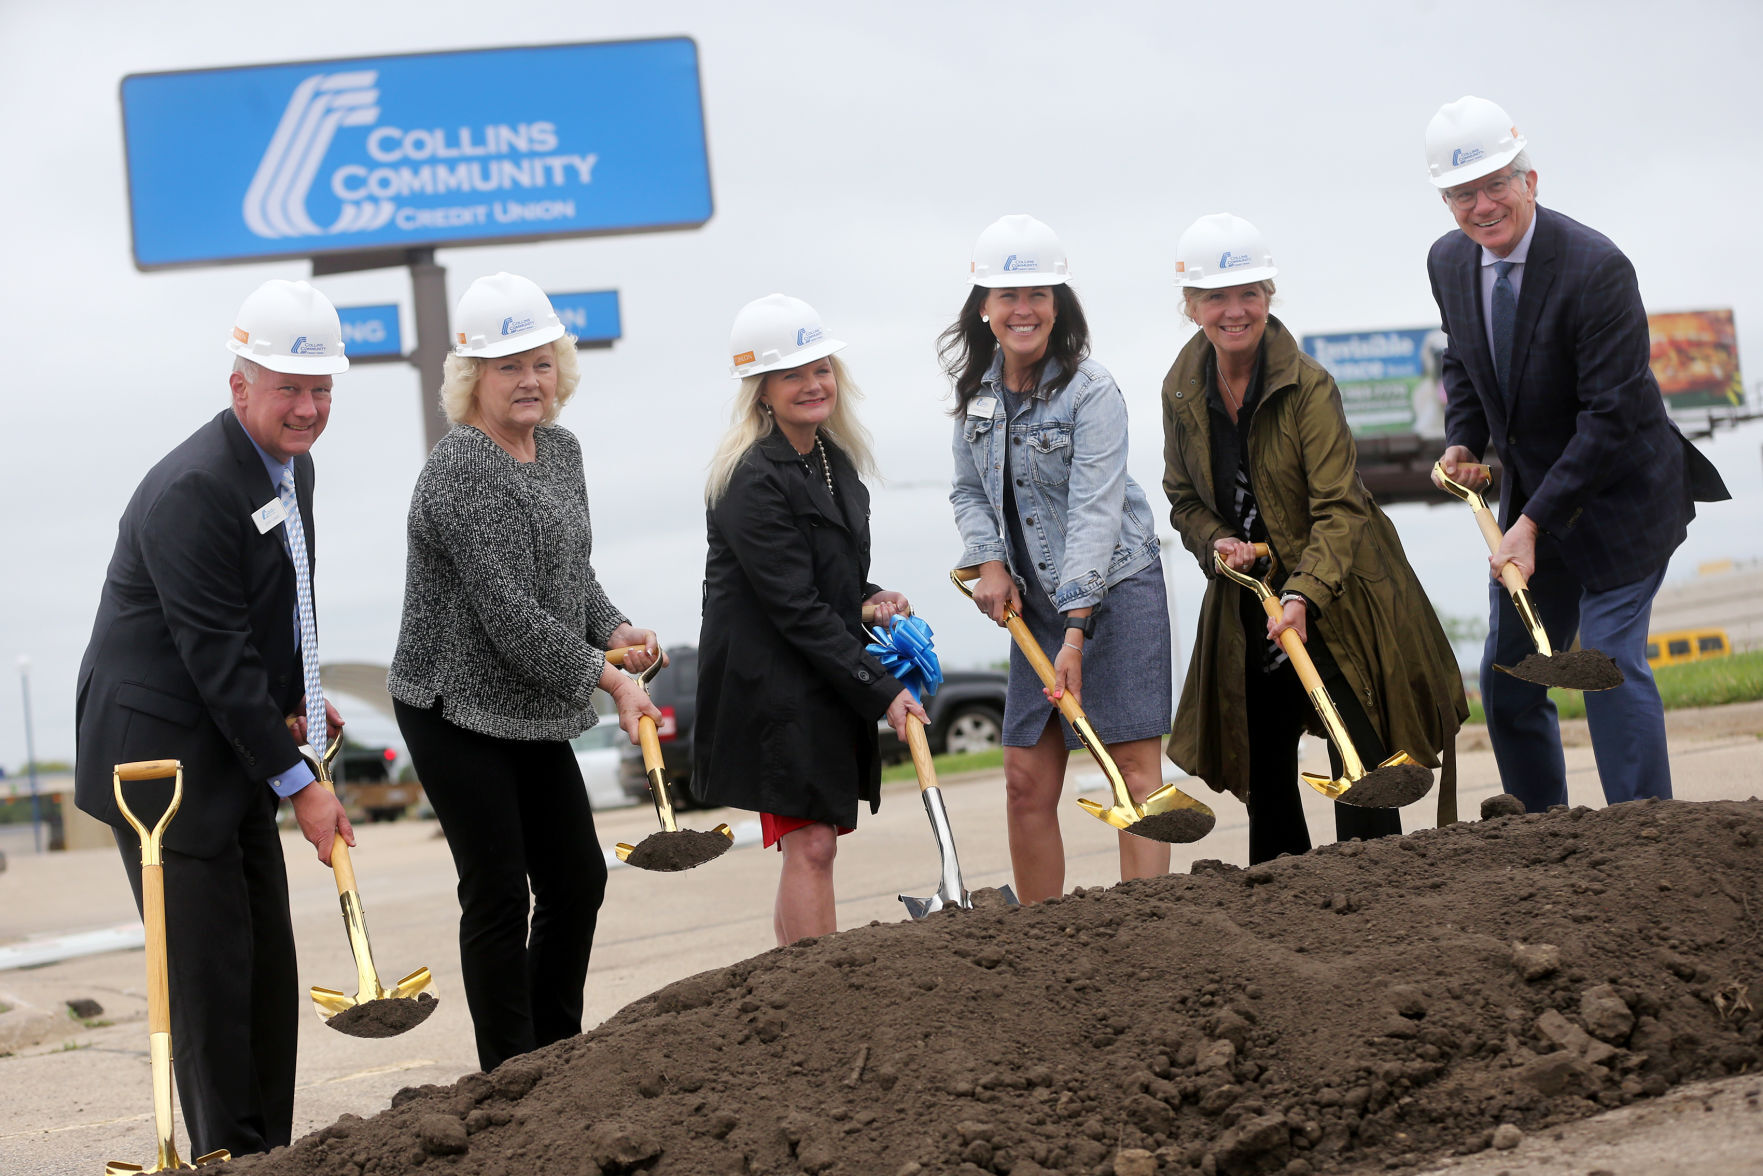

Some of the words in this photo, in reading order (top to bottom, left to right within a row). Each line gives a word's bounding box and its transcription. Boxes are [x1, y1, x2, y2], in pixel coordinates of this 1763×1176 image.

[366, 121, 558, 162] COLLINS
[331, 153, 598, 201] COMMUNITY
[395, 205, 488, 230] CREDIT
[493, 200, 576, 224] UNION
[1314, 333, 1415, 358] Invisible
